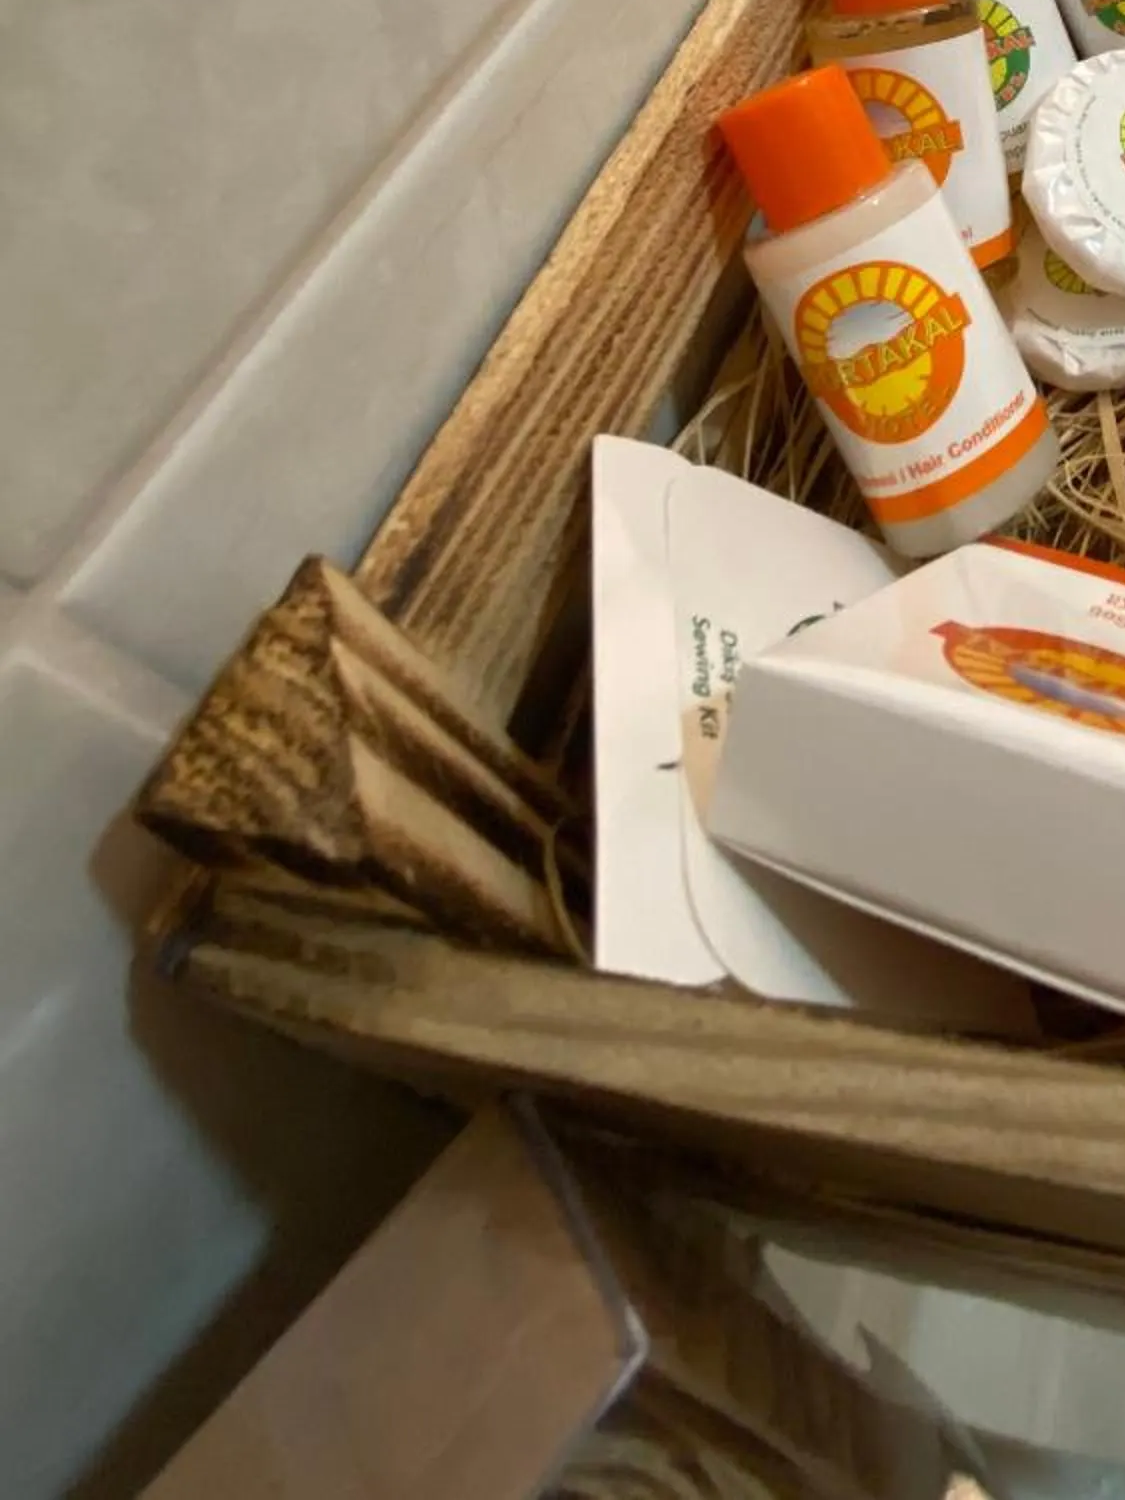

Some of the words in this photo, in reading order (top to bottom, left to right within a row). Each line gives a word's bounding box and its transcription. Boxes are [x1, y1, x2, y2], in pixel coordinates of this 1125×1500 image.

[908, 452, 944, 481] Hair
[691, 614, 714, 698] Sewing
[698, 704, 720, 741] Kit
